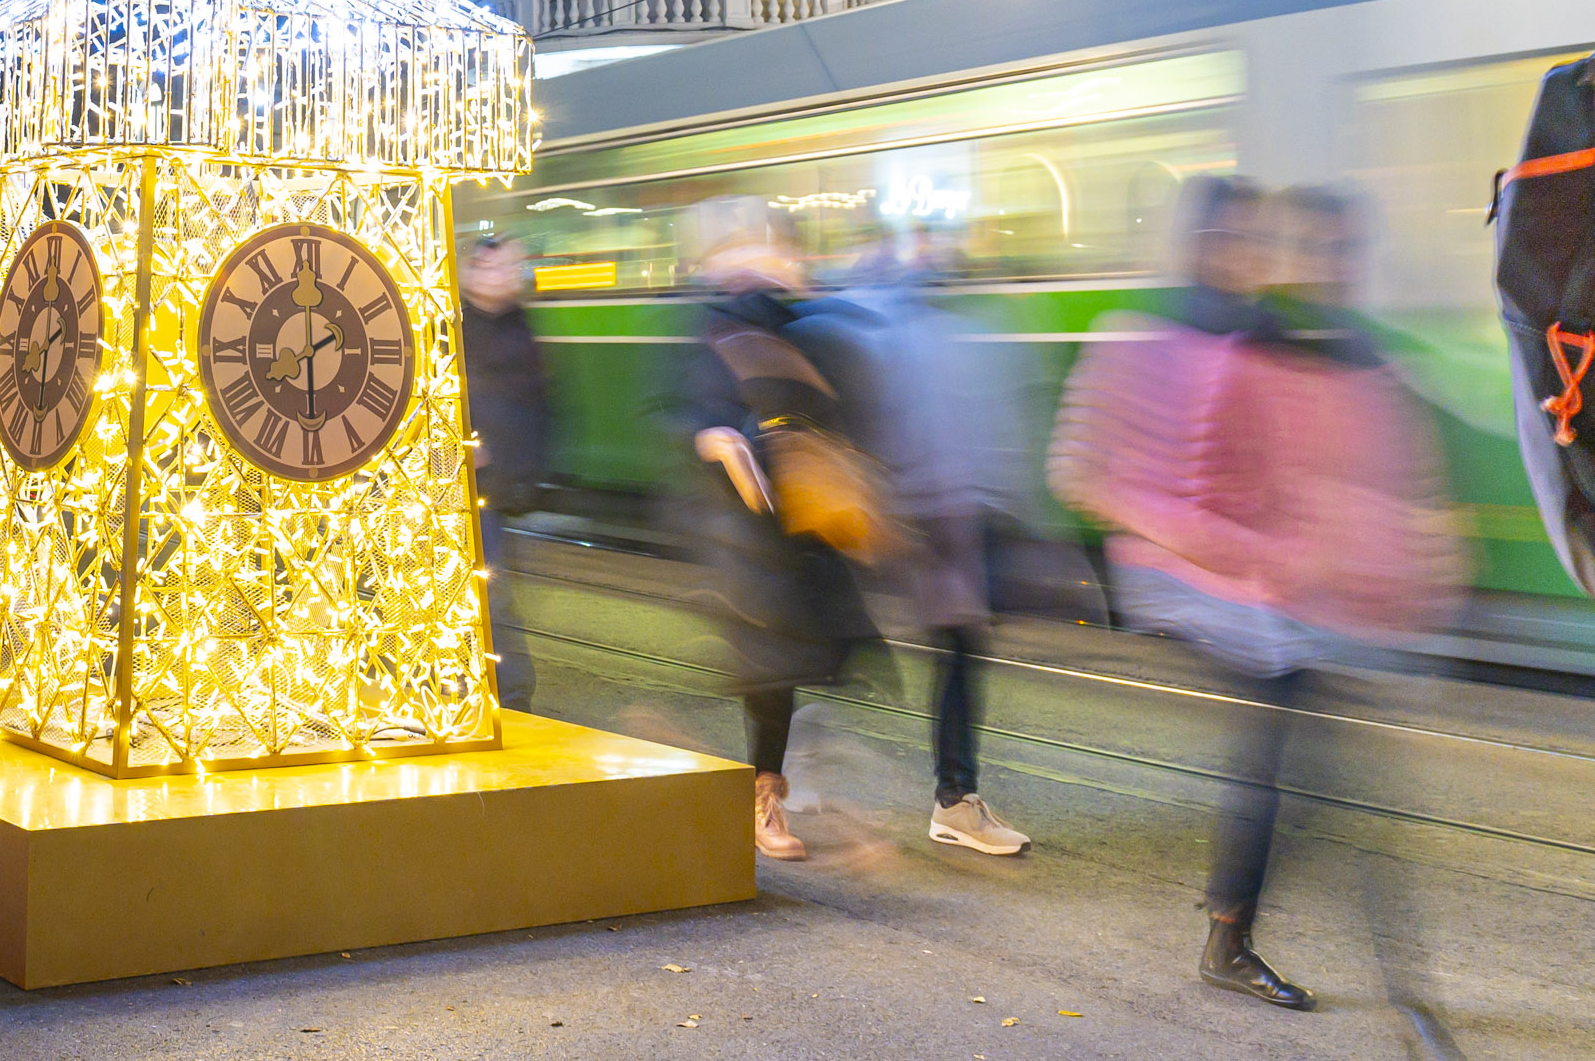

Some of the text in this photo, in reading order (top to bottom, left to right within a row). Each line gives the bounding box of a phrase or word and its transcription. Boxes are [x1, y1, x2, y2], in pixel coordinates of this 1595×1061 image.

[245, 249, 283, 295] XI
[221, 287, 258, 320] X
[359, 292, 392, 324] II
[79, 331, 96, 359] III
[369, 338, 403, 366] III
[220, 370, 265, 428] VIII
[357, 371, 398, 422] IIII
[253, 408, 290, 458] VII
